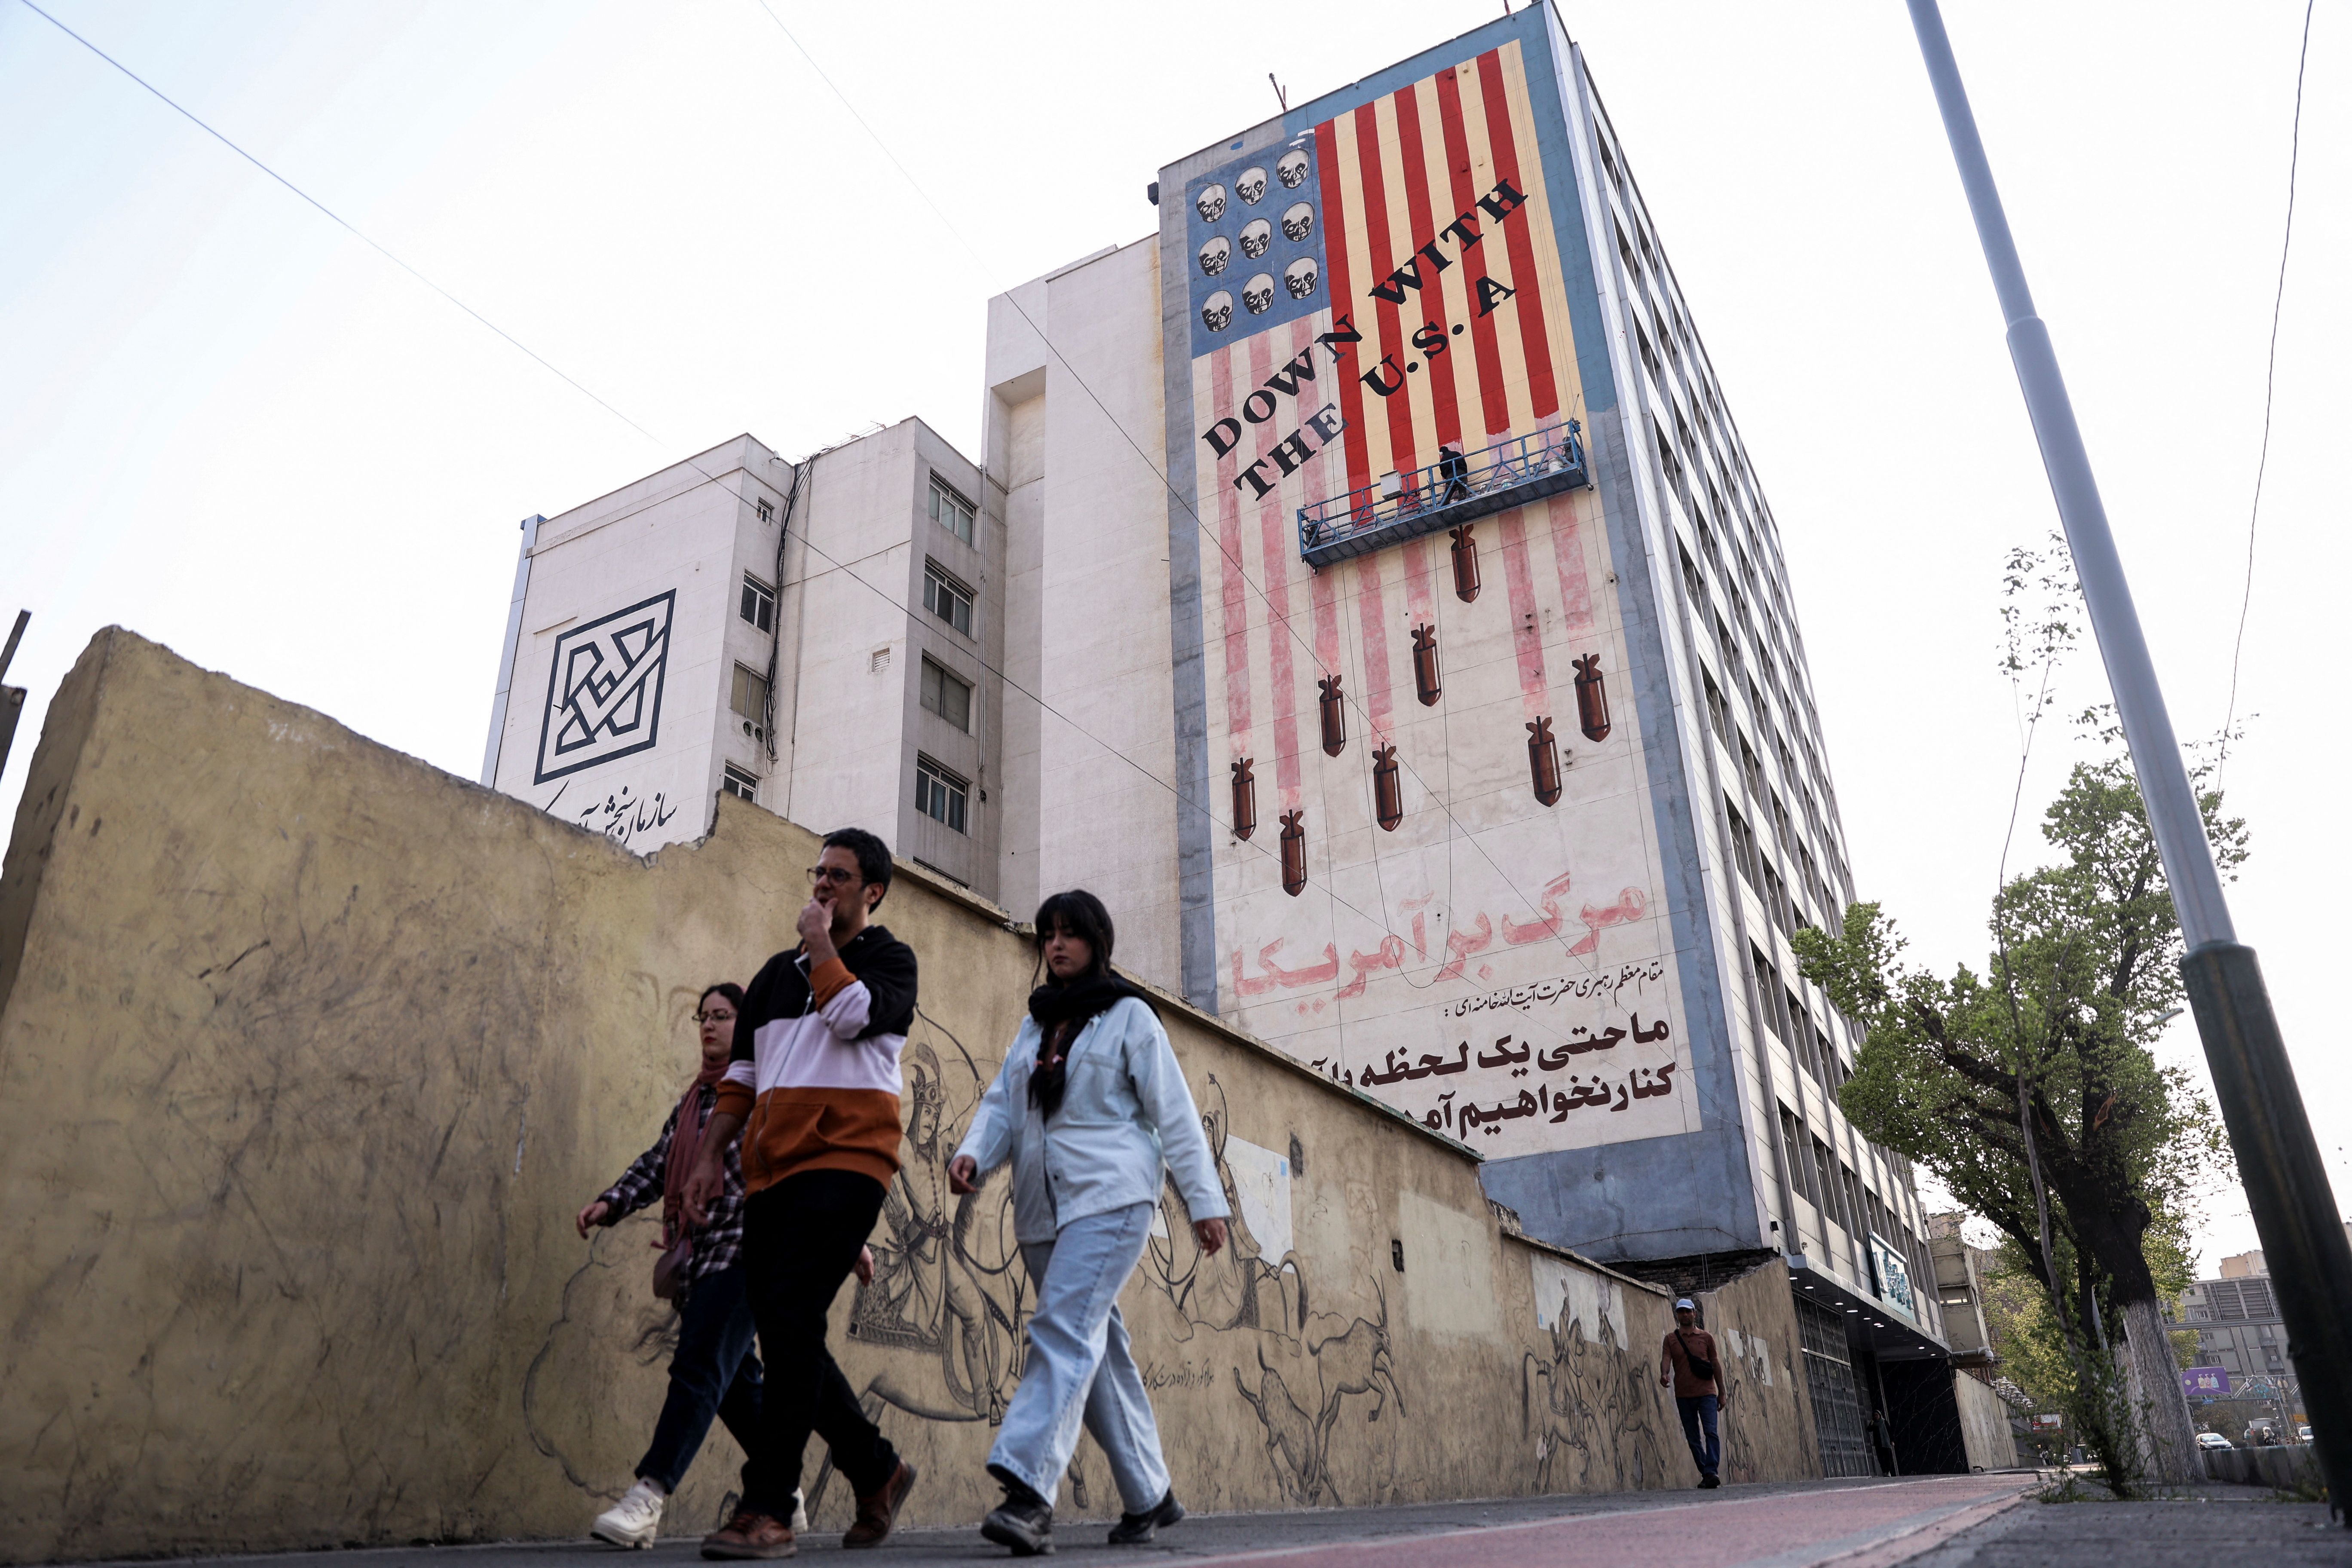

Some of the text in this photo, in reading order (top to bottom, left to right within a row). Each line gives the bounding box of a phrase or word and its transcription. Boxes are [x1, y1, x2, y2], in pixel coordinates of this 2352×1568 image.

[1201, 178, 1529, 460] DOWN WITH
[1233, 402, 1348, 501] THE
[1231, 871, 1647, 1018] مرگ بر آمریکا
[1537, 978, 1576, 1006] حضرت
[1575, 974, 1614, 999] رهبری
[1614, 965, 1641, 1008] معظم
[1638, 961, 1663, 997] مقام
[1537, 1026, 1627, 1072] حتی
[1630, 1011, 1669, 1044] ما
[1360, 1040, 1469, 1088] لحظه
[1477, 1034, 1531, 1078] یک
[1459, 1075, 1612, 1141] نخواهیم
[1610, 1062, 1675, 1112] کنار
